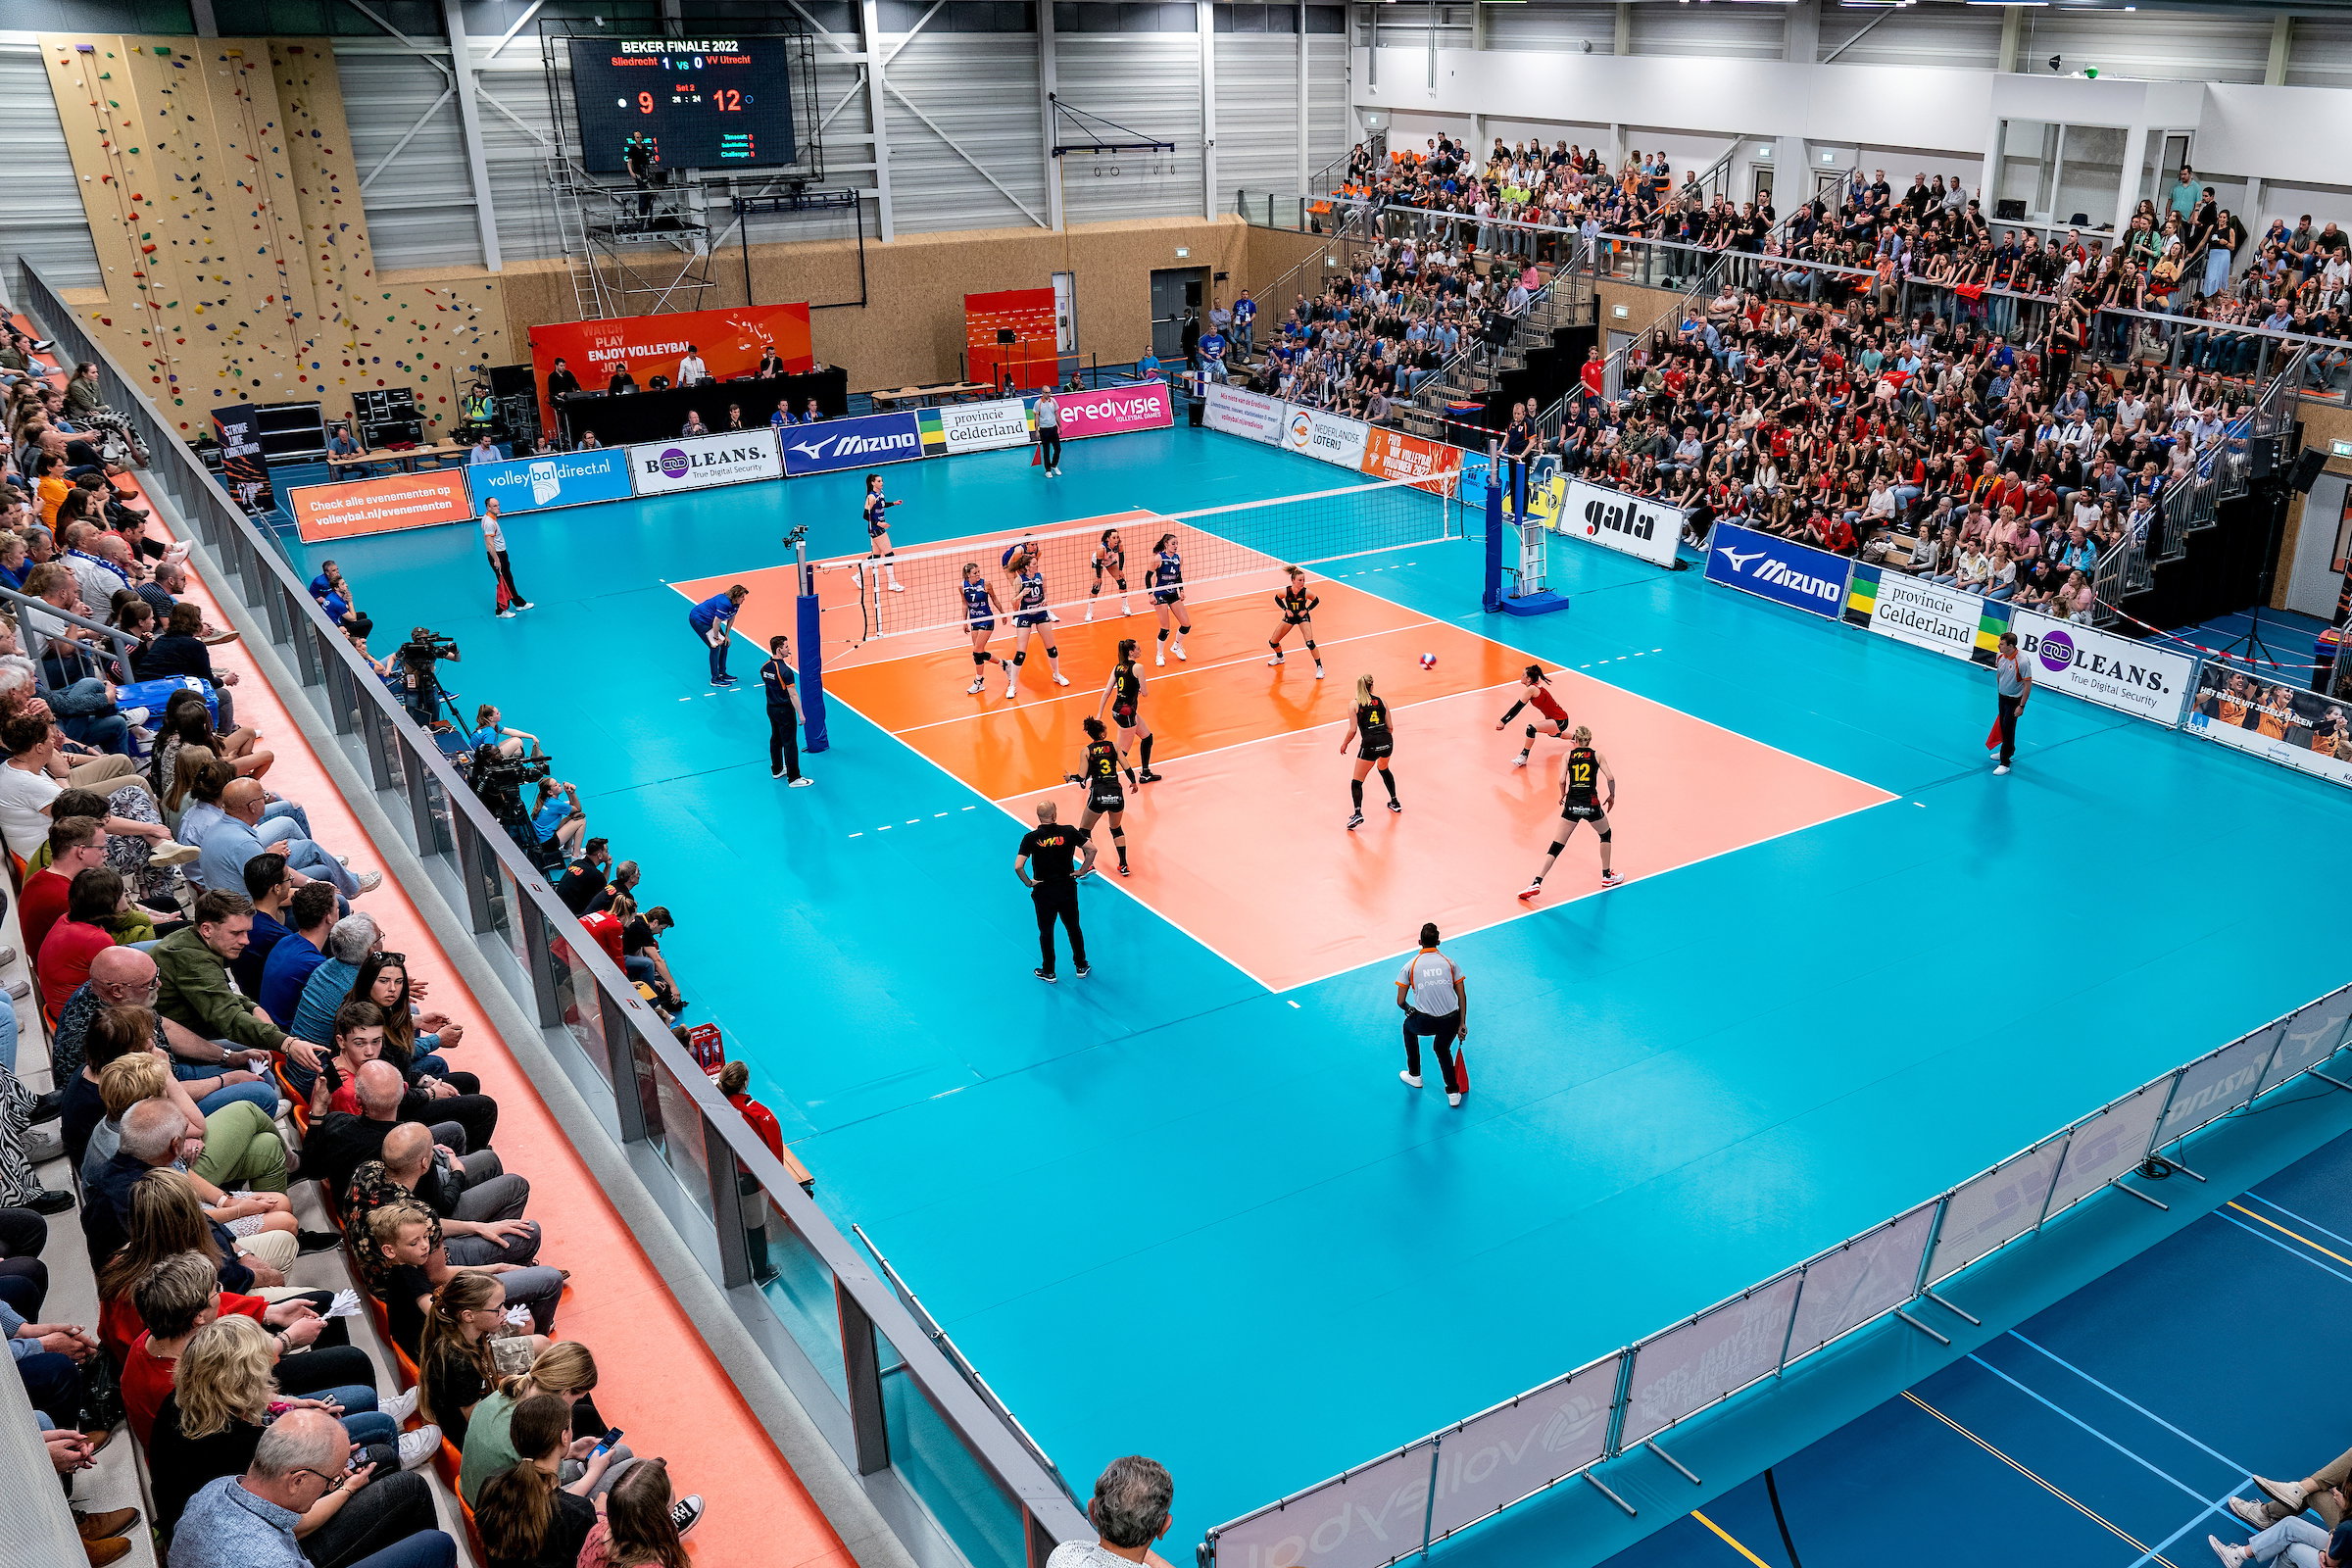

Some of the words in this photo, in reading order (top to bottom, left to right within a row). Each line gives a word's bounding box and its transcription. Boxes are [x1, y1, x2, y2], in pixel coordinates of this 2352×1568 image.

[621, 41, 665, 53] BEKER
[666, 41, 710, 53] FINALE
[712, 40, 739, 52] 2022
[611, 56, 658, 67] Sliedrecht
[662, 57, 670, 70] 1
[694, 57, 703, 69] 0
[706, 55, 718, 65] VV
[719, 55, 752, 65] Utrecht
[675, 83, 688, 92] Set
[689, 83, 696, 92] 2
[638, 91, 654, 115] 9
[712, 89, 742, 112] 12
[582, 323, 624, 337] WATCH
[595, 335, 624, 348] PLAY
[588, 347, 626, 362] ENJOY
[955, 410, 1004, 427] provincie
[1115, 413, 1144, 423] VOLLEYBAL
[1145, 411, 1162, 420] DAMES
[223, 422, 249, 437] STRIKE
[950, 422, 1024, 442] Gelderland
[1315, 422, 1360, 445] NEDERLANDSE
[222, 442, 261, 459] LIGHTNING
[1313, 434, 1342, 451] LOTERIJ
[693, 469, 710, 479] True
[710, 466, 732, 479] Digital
[733, 463, 762, 476] Security
[310, 498, 344, 513] Check
[345, 496, 365, 508] alle
[366, 490, 436, 506] evenementen
[437, 486, 451, 499] op
[316, 499, 453, 527] volleybal.nl/evenementen
[1585, 500, 1655, 541] gala
[970, 593, 976, 602] 7
[1030, 586, 1041, 598] 10
[1892, 586, 1953, 614] provincie
[1880, 604, 1970, 644] Gelderland
[1118, 676, 1124, 691] 9
[2071, 672, 2089, 687] True
[2091, 678, 2119, 698] Digital
[2121, 687, 2158, 709] Security
[2199, 686, 2215, 698] HET
[2216, 691, 2241, 706] BESTE
[2241, 699, 2255, 710] UIT
[2284, 710, 2314, 728] HALEN
[1369, 710, 1380, 724] 4
[1100, 759, 1111, 774] 3
[1571, 762, 1591, 782] 12
[1422, 967, 1443, 977] NTO
